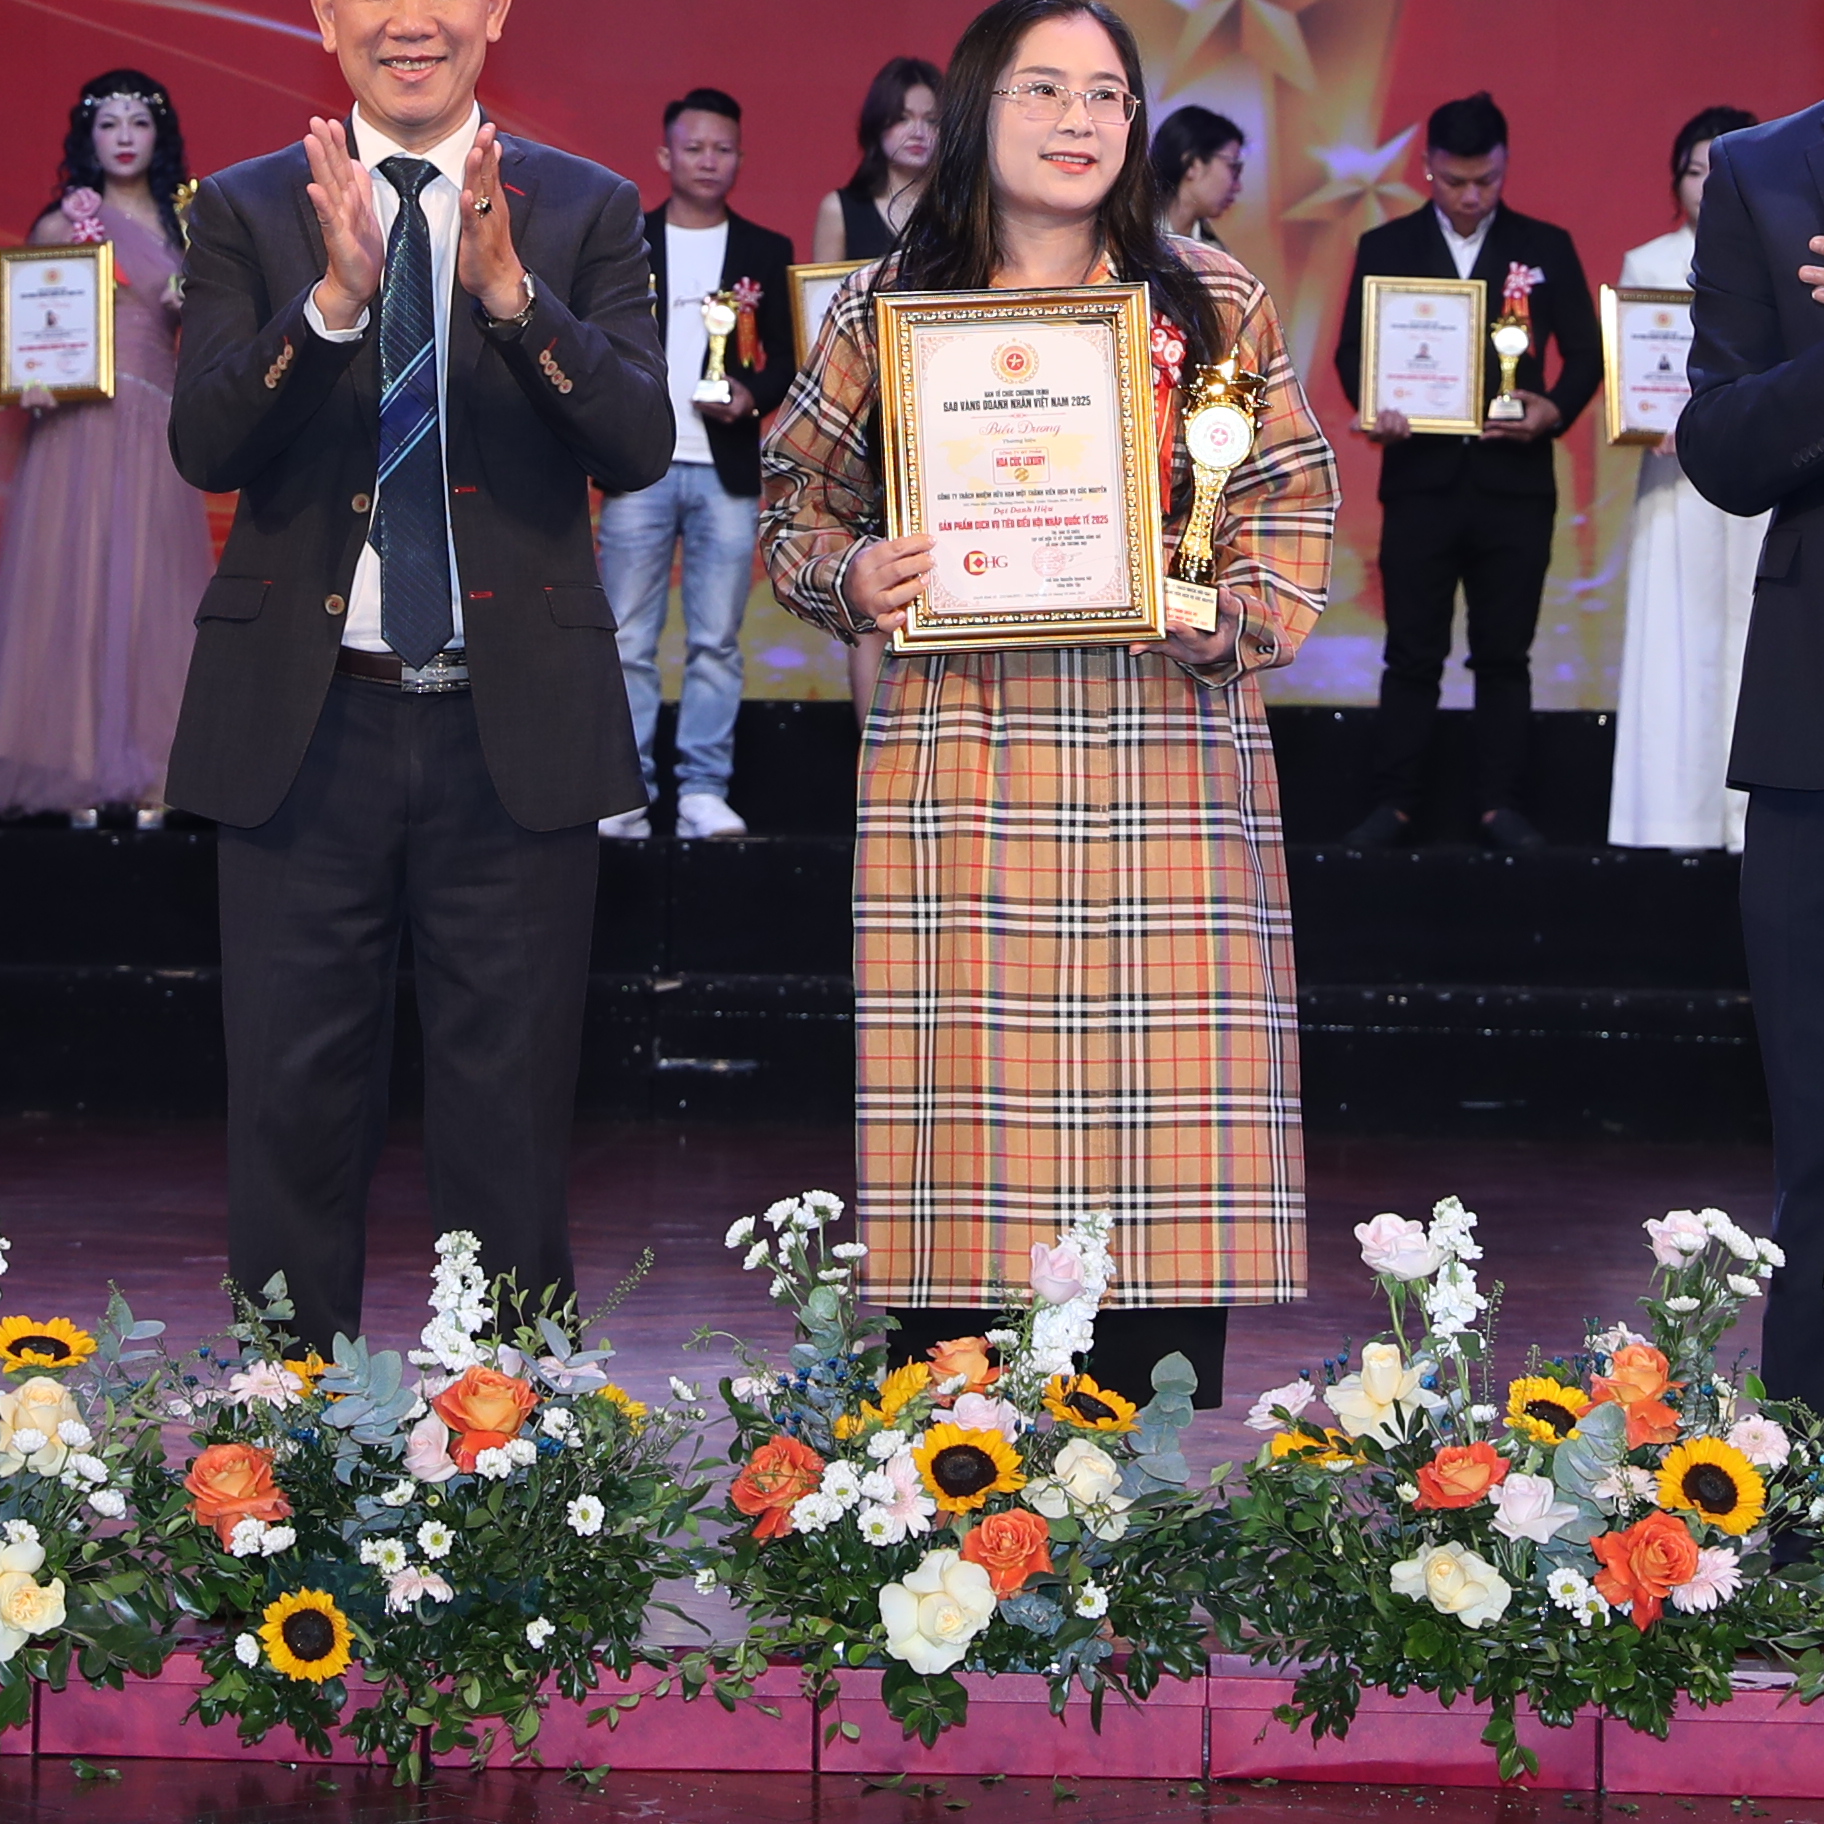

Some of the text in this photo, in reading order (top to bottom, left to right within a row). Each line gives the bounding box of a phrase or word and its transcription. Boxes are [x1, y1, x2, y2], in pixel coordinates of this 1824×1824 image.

[1151, 328, 1185, 363] 36
[943, 395, 1091, 412] SAO VÀNG DOANH NHÂN VIỆT NAM 2025
[996, 454, 1045, 467] HOA CÚC LUXURY
[1082, 512, 1091, 525] TẾ
[1091, 514, 1109, 526] 2025
